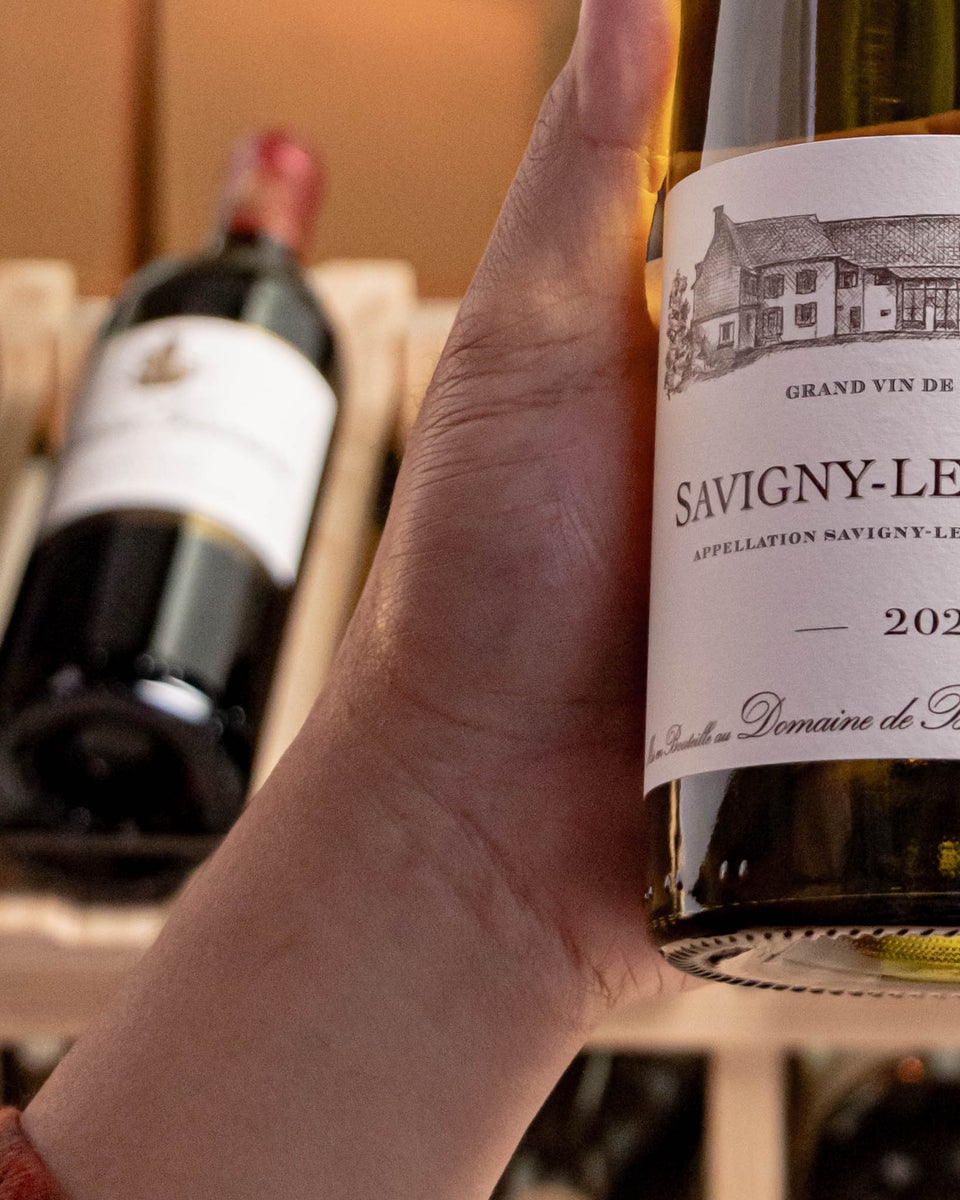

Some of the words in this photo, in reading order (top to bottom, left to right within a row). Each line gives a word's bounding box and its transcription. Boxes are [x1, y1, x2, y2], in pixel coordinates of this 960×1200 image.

[785, 380, 866, 399] GRAND
[872, 378, 915, 392] VIN
[921, 378, 954, 392] DE
[693, 530, 816, 562] APPELLATION
[737, 691, 873, 740] Domaine
[879, 697, 919, 730] de
